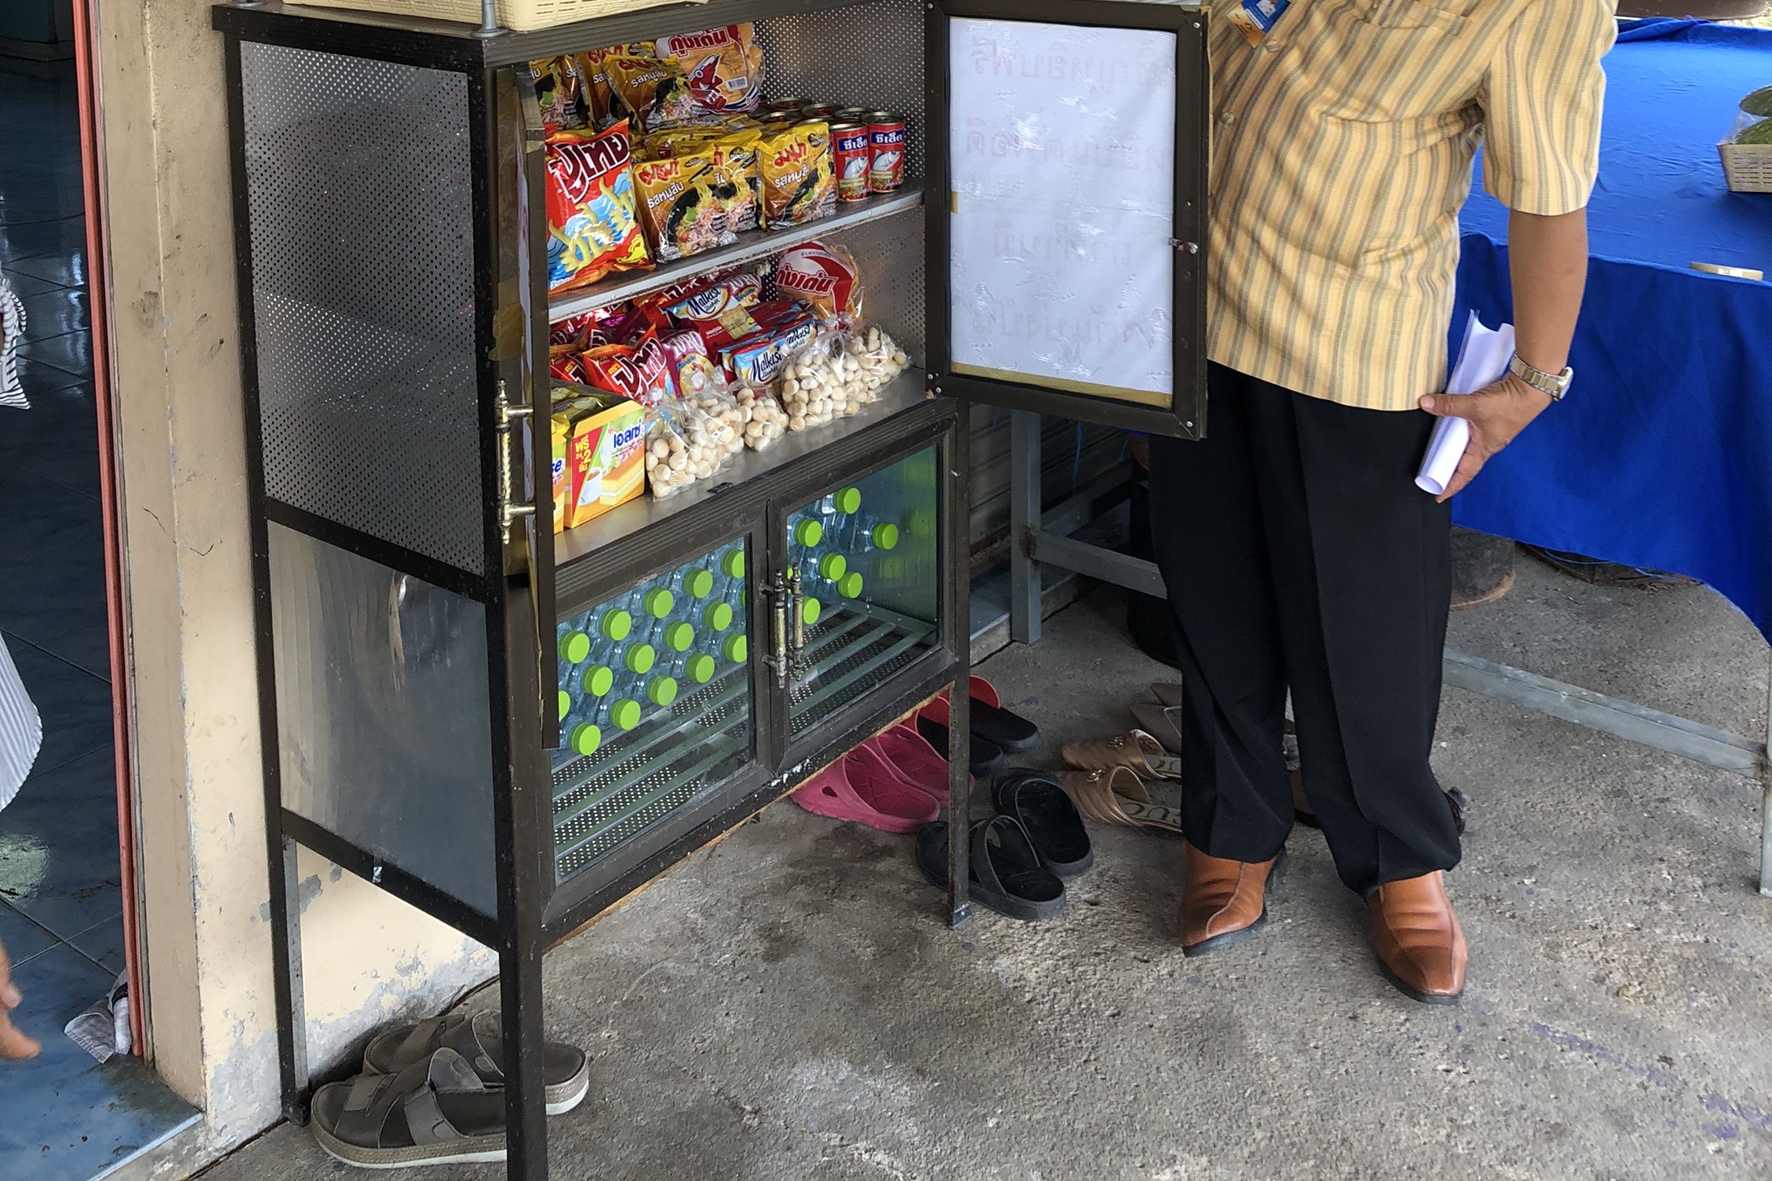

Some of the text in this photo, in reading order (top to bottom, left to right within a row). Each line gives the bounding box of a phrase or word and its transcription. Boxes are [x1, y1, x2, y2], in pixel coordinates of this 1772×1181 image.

[774, 163, 810, 188] รสหมูสั
[647, 181, 685, 208] รสหมูสับ
[687, 286, 721, 318] Malkist
